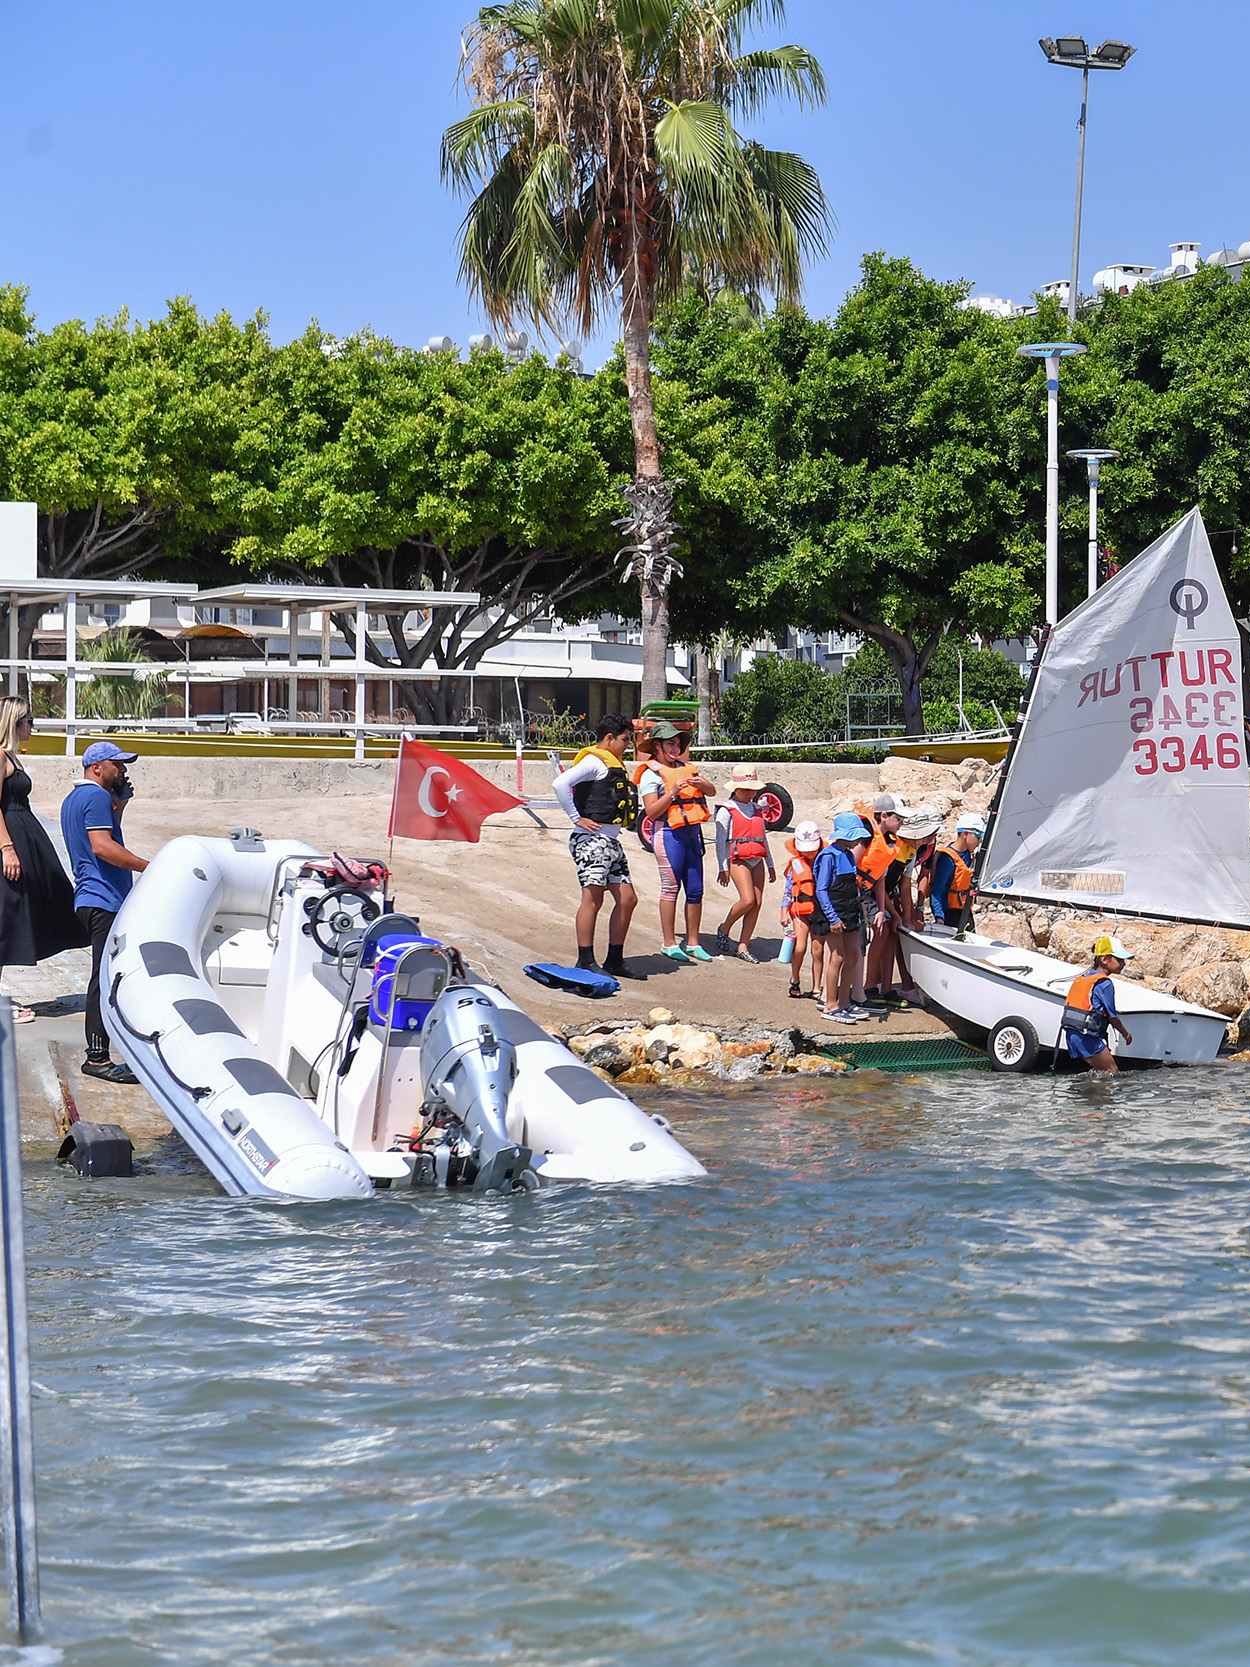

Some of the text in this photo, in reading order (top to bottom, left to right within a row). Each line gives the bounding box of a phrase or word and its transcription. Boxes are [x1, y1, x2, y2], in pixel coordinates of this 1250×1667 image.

[1151, 649, 1236, 689] TUR
[1133, 732, 1241, 776] 3346
[457, 996, 493, 1009] 50
[239, 1135, 271, 1173] NORTHSTAR
